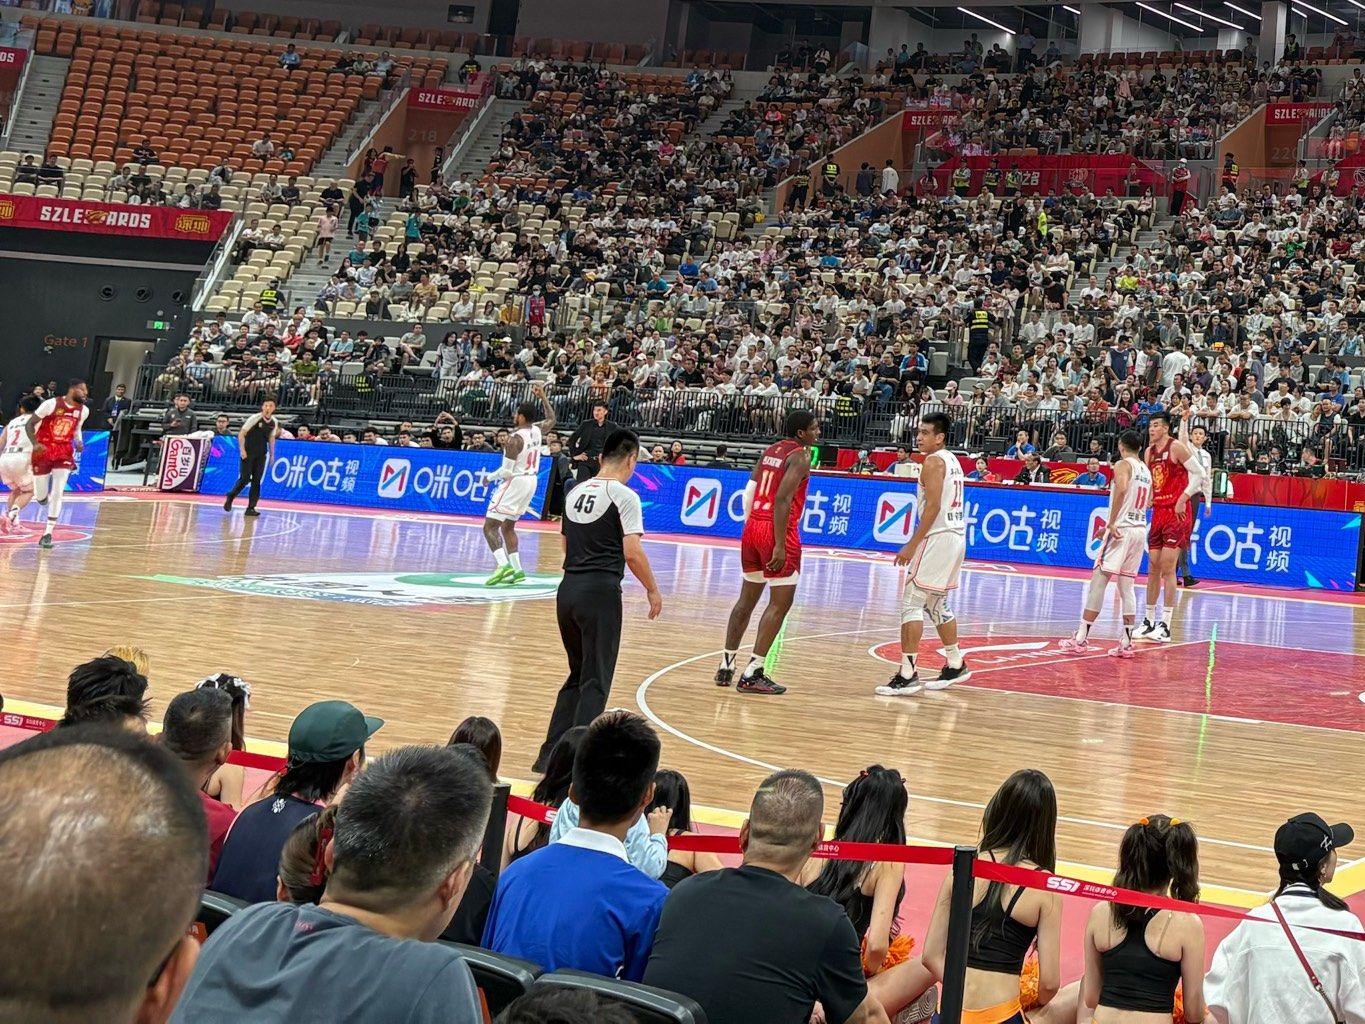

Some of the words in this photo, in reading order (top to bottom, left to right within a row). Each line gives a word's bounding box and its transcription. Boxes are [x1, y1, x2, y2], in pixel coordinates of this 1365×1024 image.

[40, 205, 152, 229] SZLEARDS
[44, 335, 77, 348] Gate
[272, 454, 341, 491] 咪咕
[760, 469, 774, 496] 11
[573, 493, 596, 514] 45
[1046, 875, 1081, 893] SSI
